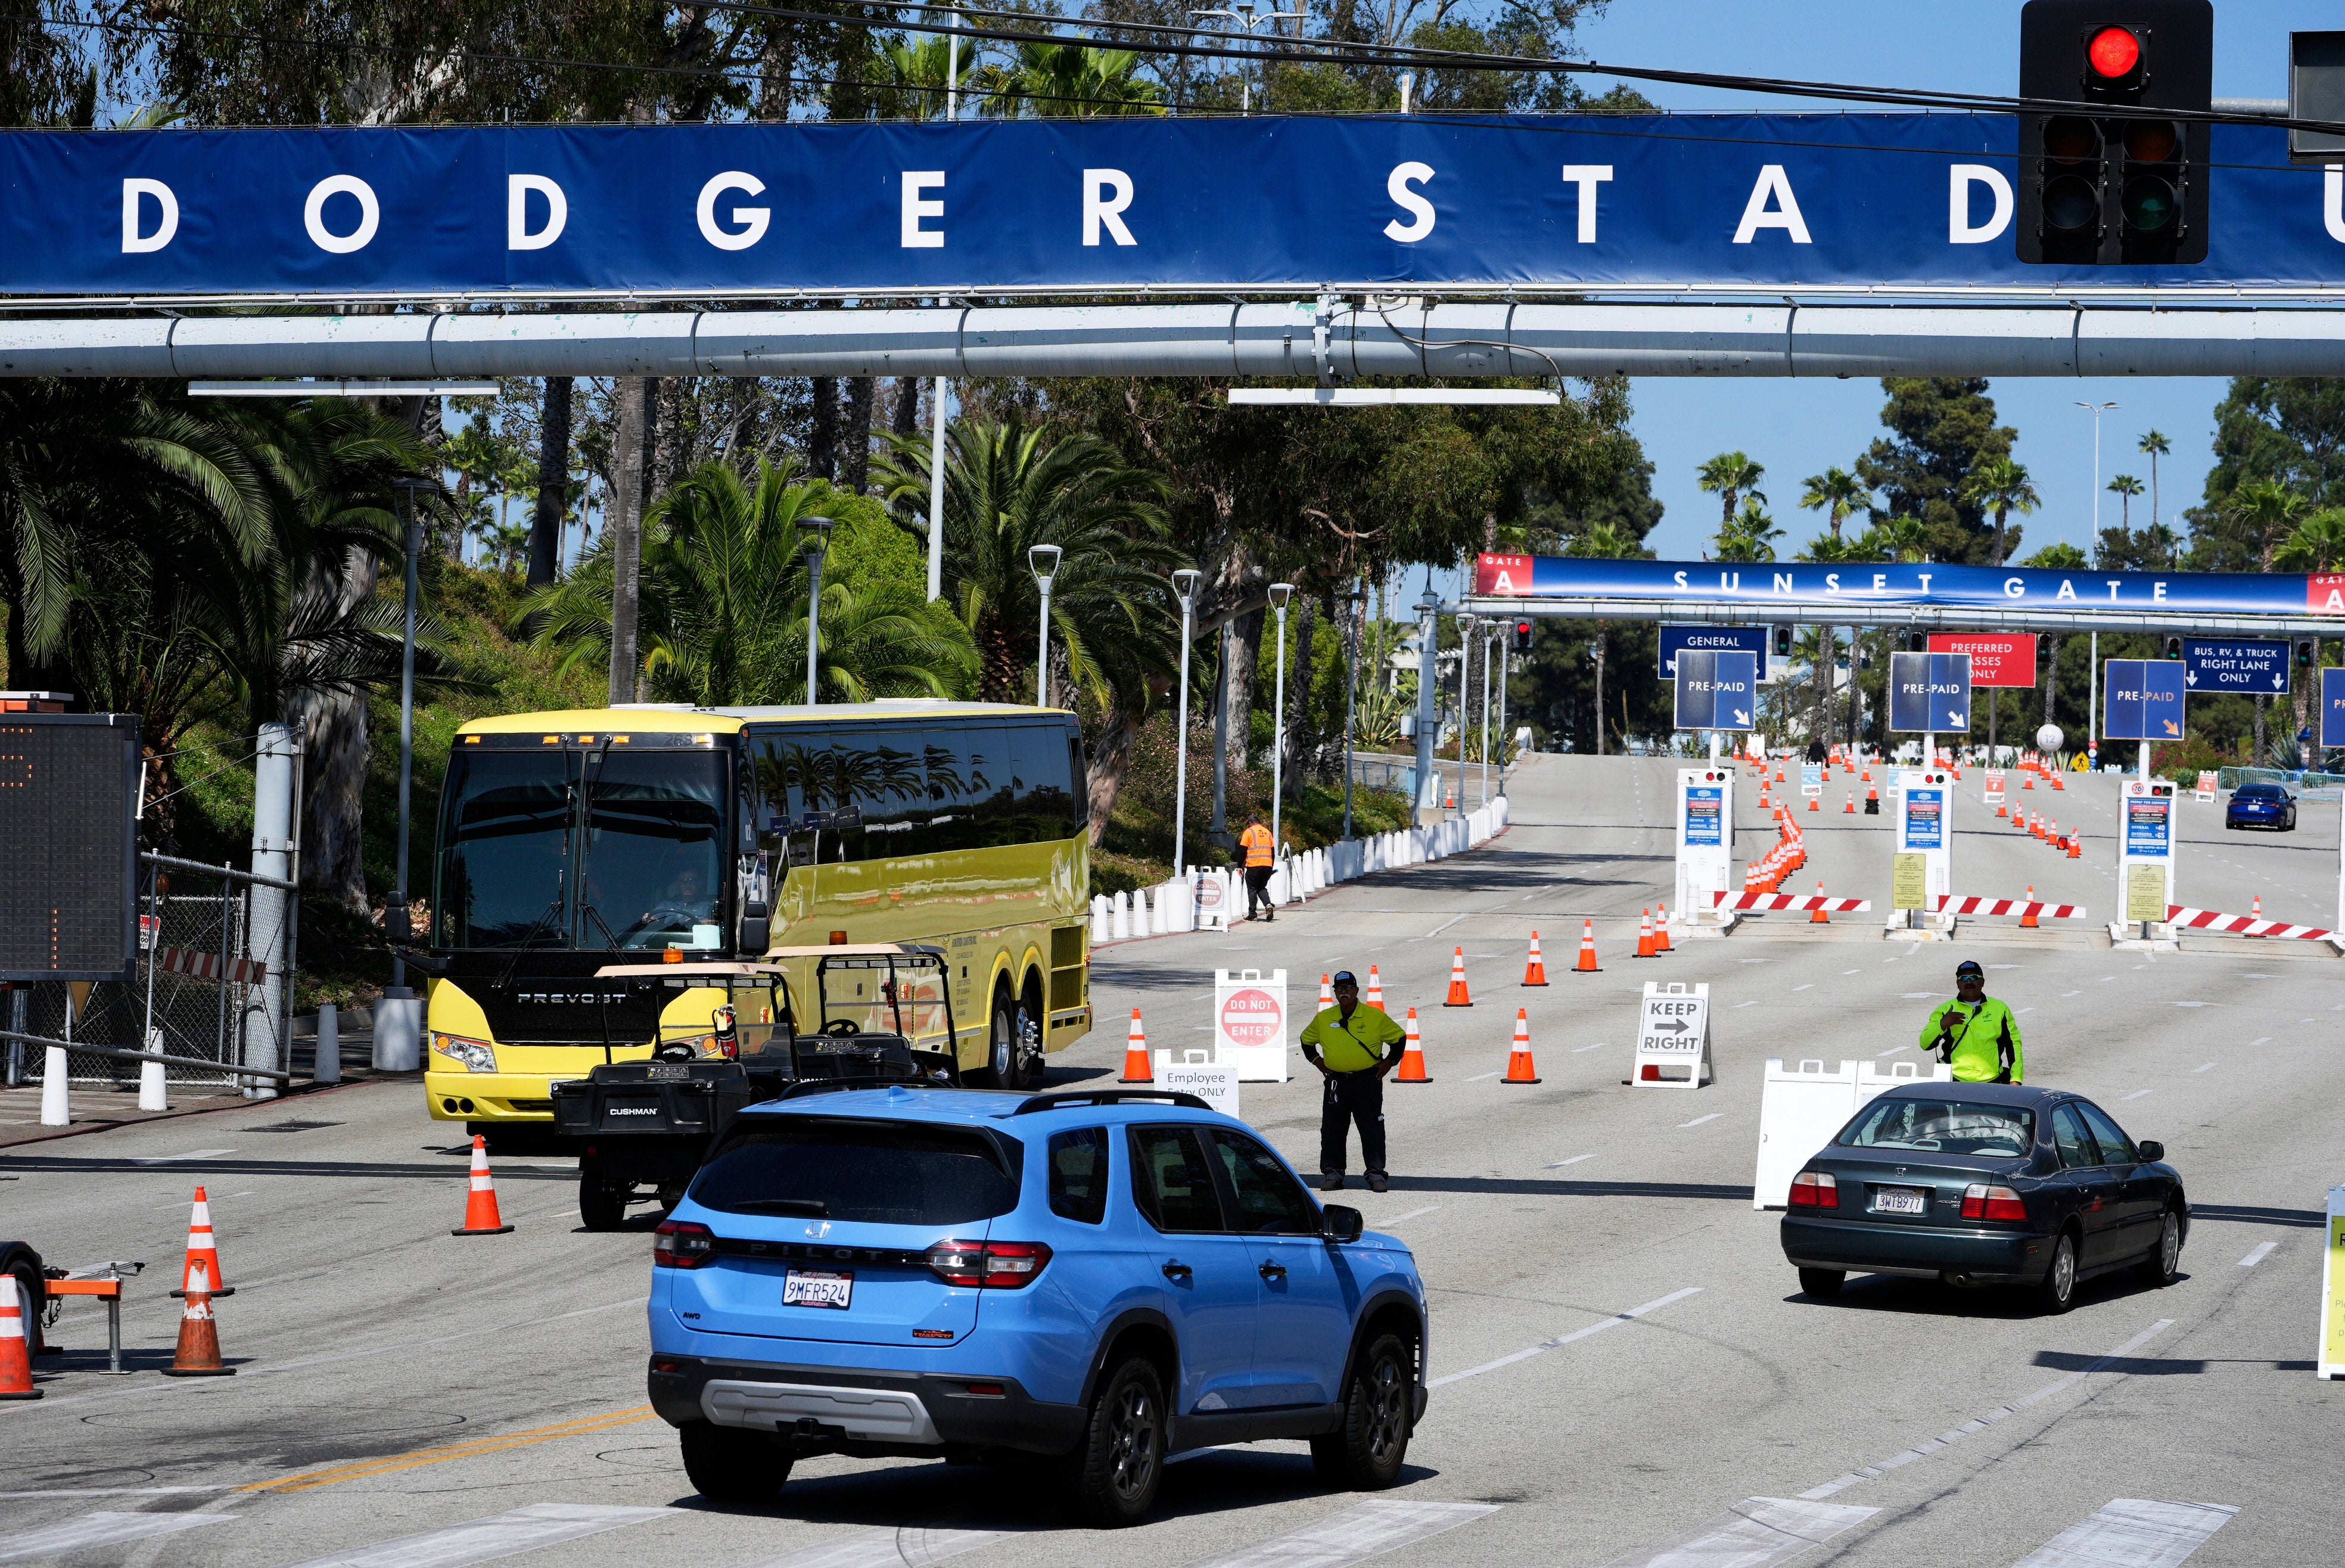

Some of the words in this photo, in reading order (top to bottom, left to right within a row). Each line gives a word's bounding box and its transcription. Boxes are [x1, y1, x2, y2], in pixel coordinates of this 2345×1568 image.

[122, 169, 1137, 253] DODGER
[1485, 556, 1520, 566] GATE
[1494, 570, 1514, 590] A
[1674, 570, 1932, 595] SUNSET
[2004, 577, 2167, 602] GATE
[2325, 589, 2345, 609] A
[1687, 636, 1740, 647] GENERAL
[1951, 643, 2012, 653] PREFERRED
[2195, 647, 2216, 657] BUS,
[2219, 648, 2233, 658] RV,
[2246, 649, 2277, 658] TRUCK
[2201, 659, 2236, 670] RIGHT
[2240, 661, 2270, 670] LANE
[2219, 673, 2251, 683] ONLY
[1688, 681, 1745, 692] PRE-PAID
[1903, 684, 1960, 694] PRE-PAID
[2117, 691, 2175, 703] PRE-PAID
[2044, 734, 2055, 744] 12
[518, 994, 626, 1003] PREVOST
[1230, 1000, 1246, 1010] DO
[1250, 1000, 1273, 1010] NOT
[1650, 1003, 1697, 1016] KEEP
[1231, 1026, 1271, 1036] ENTER
[1644, 1037, 1699, 1050] RIGHT
[1168, 1072, 1225, 1085] Employee
[1198, 1088, 1226, 1096] ONLY
[1879, 1195, 1921, 1210] 3WTB977
[750, 1243, 883, 1261] PILOT
[787, 1281, 845, 1302] 9MFR524
